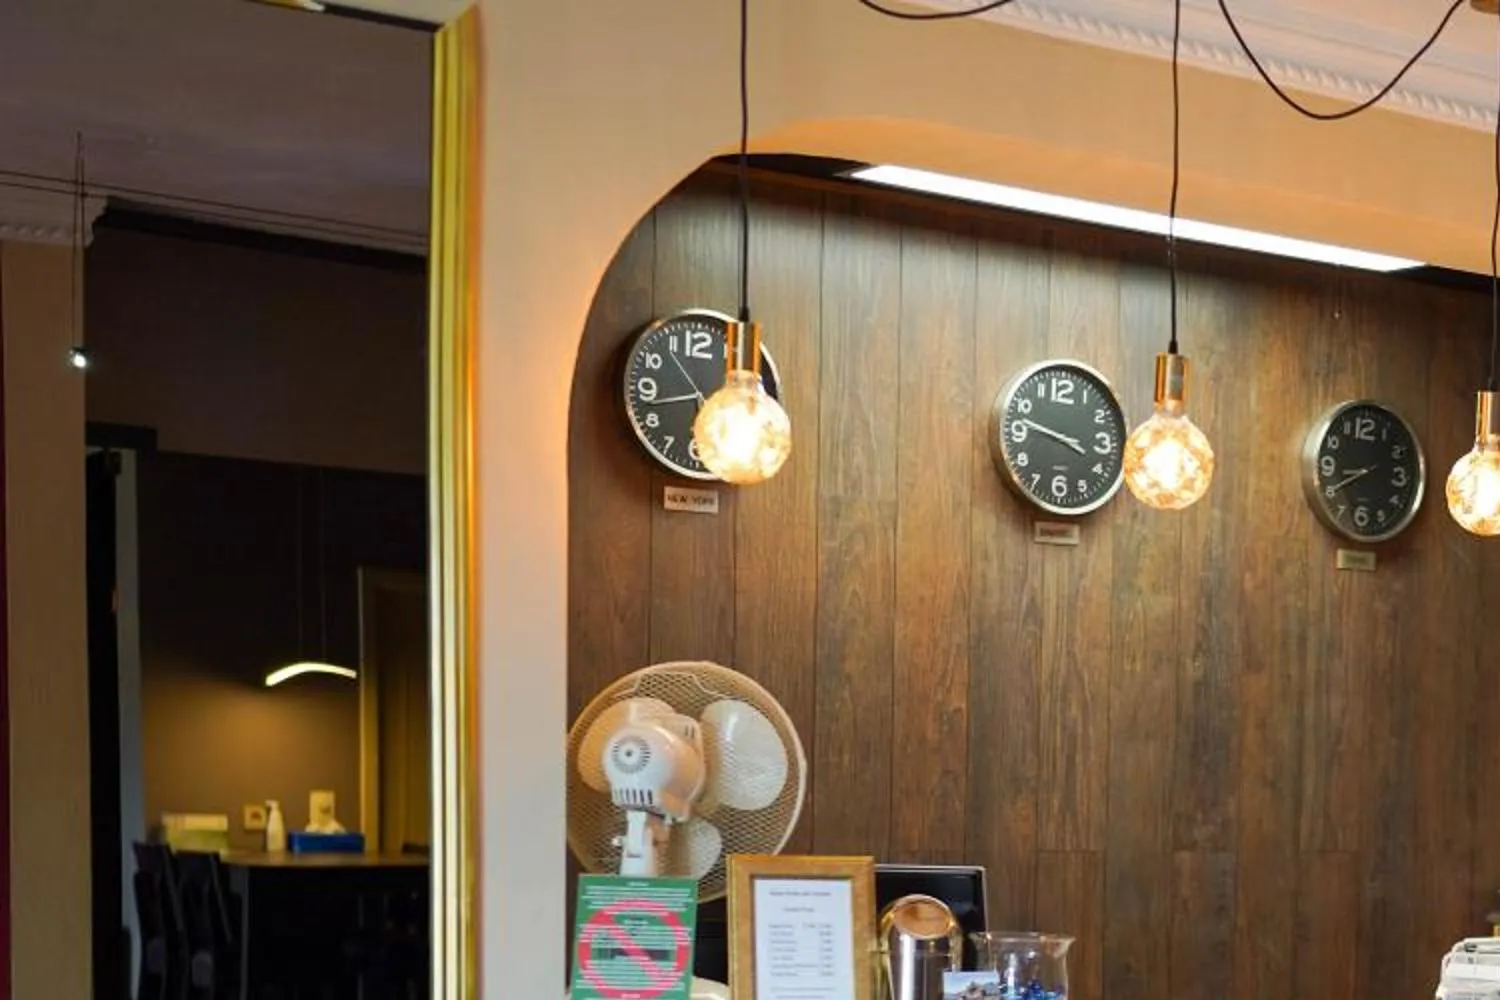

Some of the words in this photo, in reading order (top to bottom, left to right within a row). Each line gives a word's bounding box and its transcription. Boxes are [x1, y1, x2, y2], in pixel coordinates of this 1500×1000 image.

[685, 330, 713, 359] 12
[645, 352, 663, 370] 10
[638, 377, 657, 401] 9
[1051, 378, 1074, 405] 12
[1017, 399, 1032, 414] 10
[645, 413, 660, 428] 8
[1094, 409, 1105, 424] 2
[1011, 420, 1027, 443] 9
[1355, 417, 1375, 441] 12
[663, 436, 675, 455] 7
[1093, 432, 1111, 455] 3
[1327, 435, 1339, 449] 10
[1017, 452, 1029, 467] 8
[1321, 455, 1336, 477] 9
[1092, 463, 1103, 475] 4
[1391, 467, 1406, 487] 3
[1031, 474, 1041, 490] 7
[1052, 475, 1067, 497] 6
[1078, 479, 1087, 493] 5
[1326, 485, 1335, 498] 8
[1336, 505, 1345, 522] 7
[1354, 506, 1369, 527] 6
